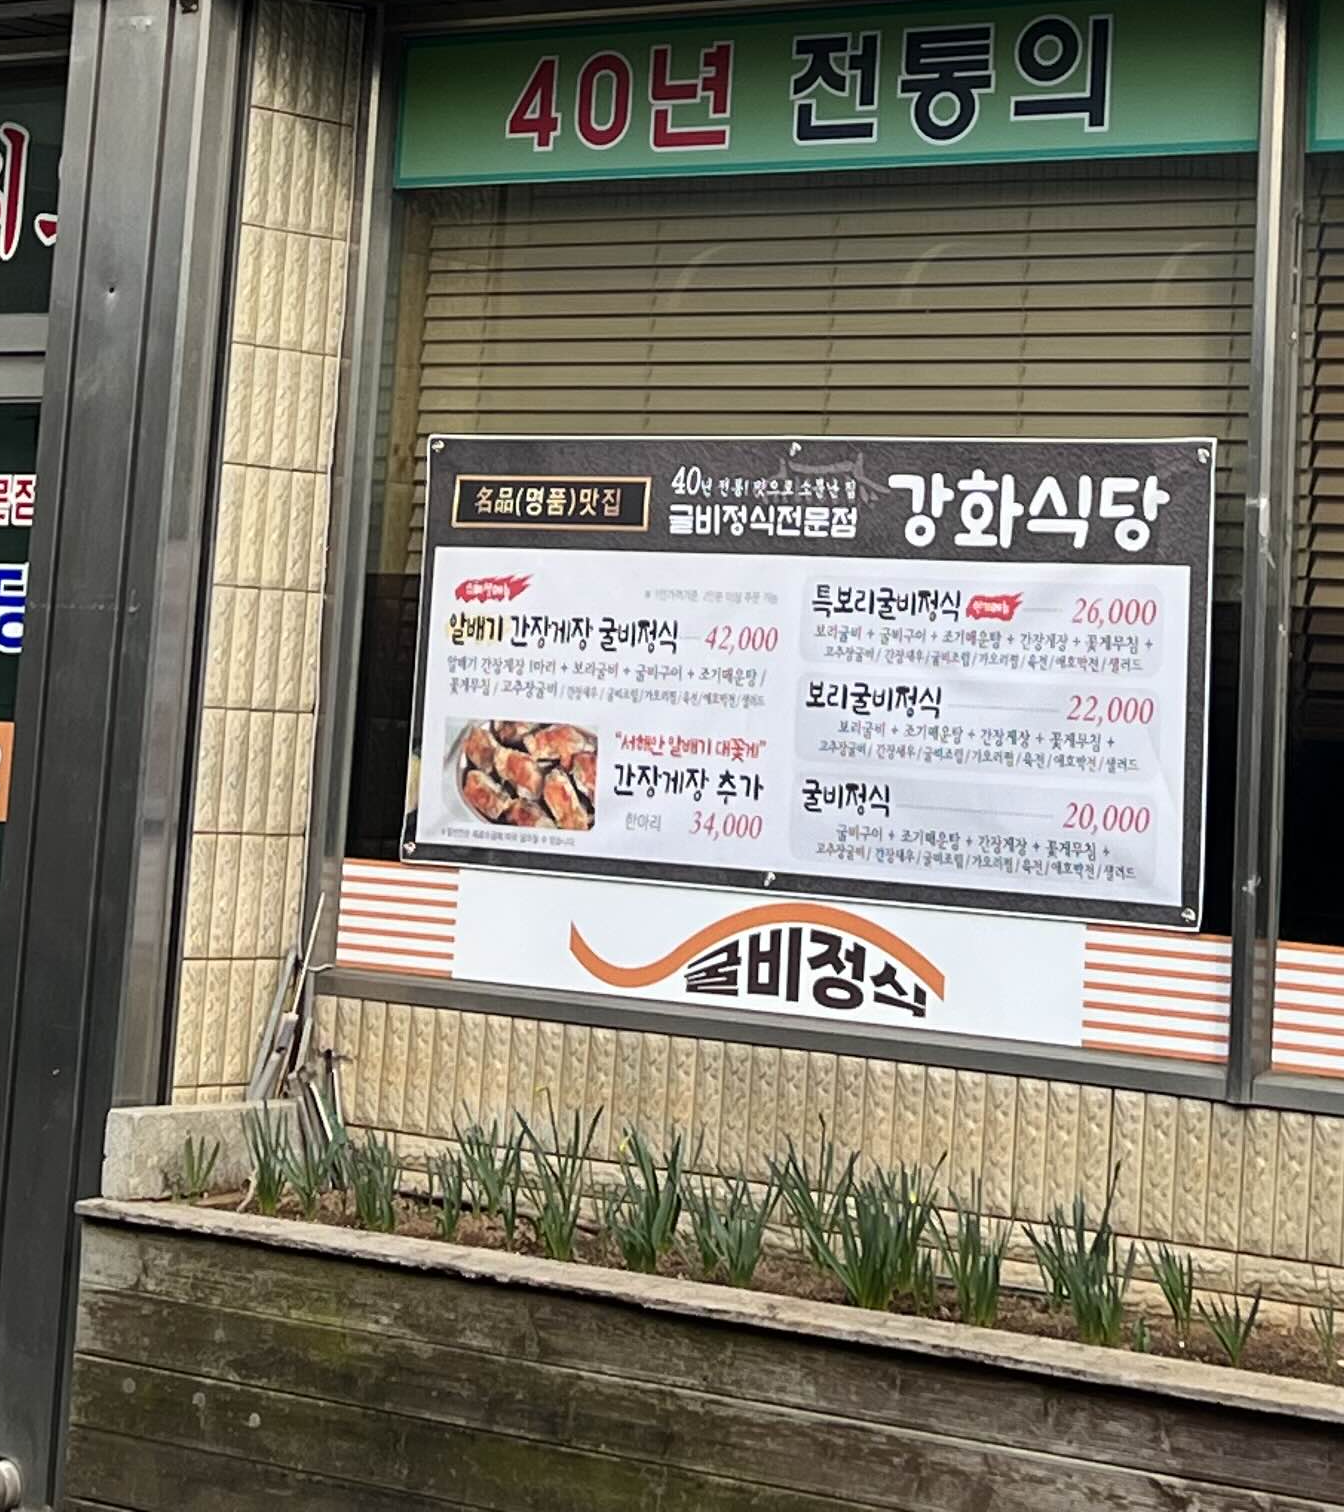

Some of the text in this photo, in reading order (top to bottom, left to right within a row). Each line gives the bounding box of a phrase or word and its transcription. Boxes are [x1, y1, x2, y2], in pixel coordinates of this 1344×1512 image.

[504, 13, 1115, 152] 40년 전통의
[669, 502, 857, 539] 굴비정식전문점
[888, 468, 1170, 552] 강화식당
[812, 584, 962, 623] 특보리굴비정식
[1072, 597, 1158, 628] 26,000
[449, 612, 779, 656] 알배기 간장게장 굴비정식 42,000
[805, 681, 1155, 726] 보리굴비정식 22,000
[613, 763, 764, 805] 간장게장 추가
[689, 810, 763, 840] 34,000
[802, 779, 1151, 834] 굴비정식 20,000
[683, 926, 927, 1018] 굴비정식
